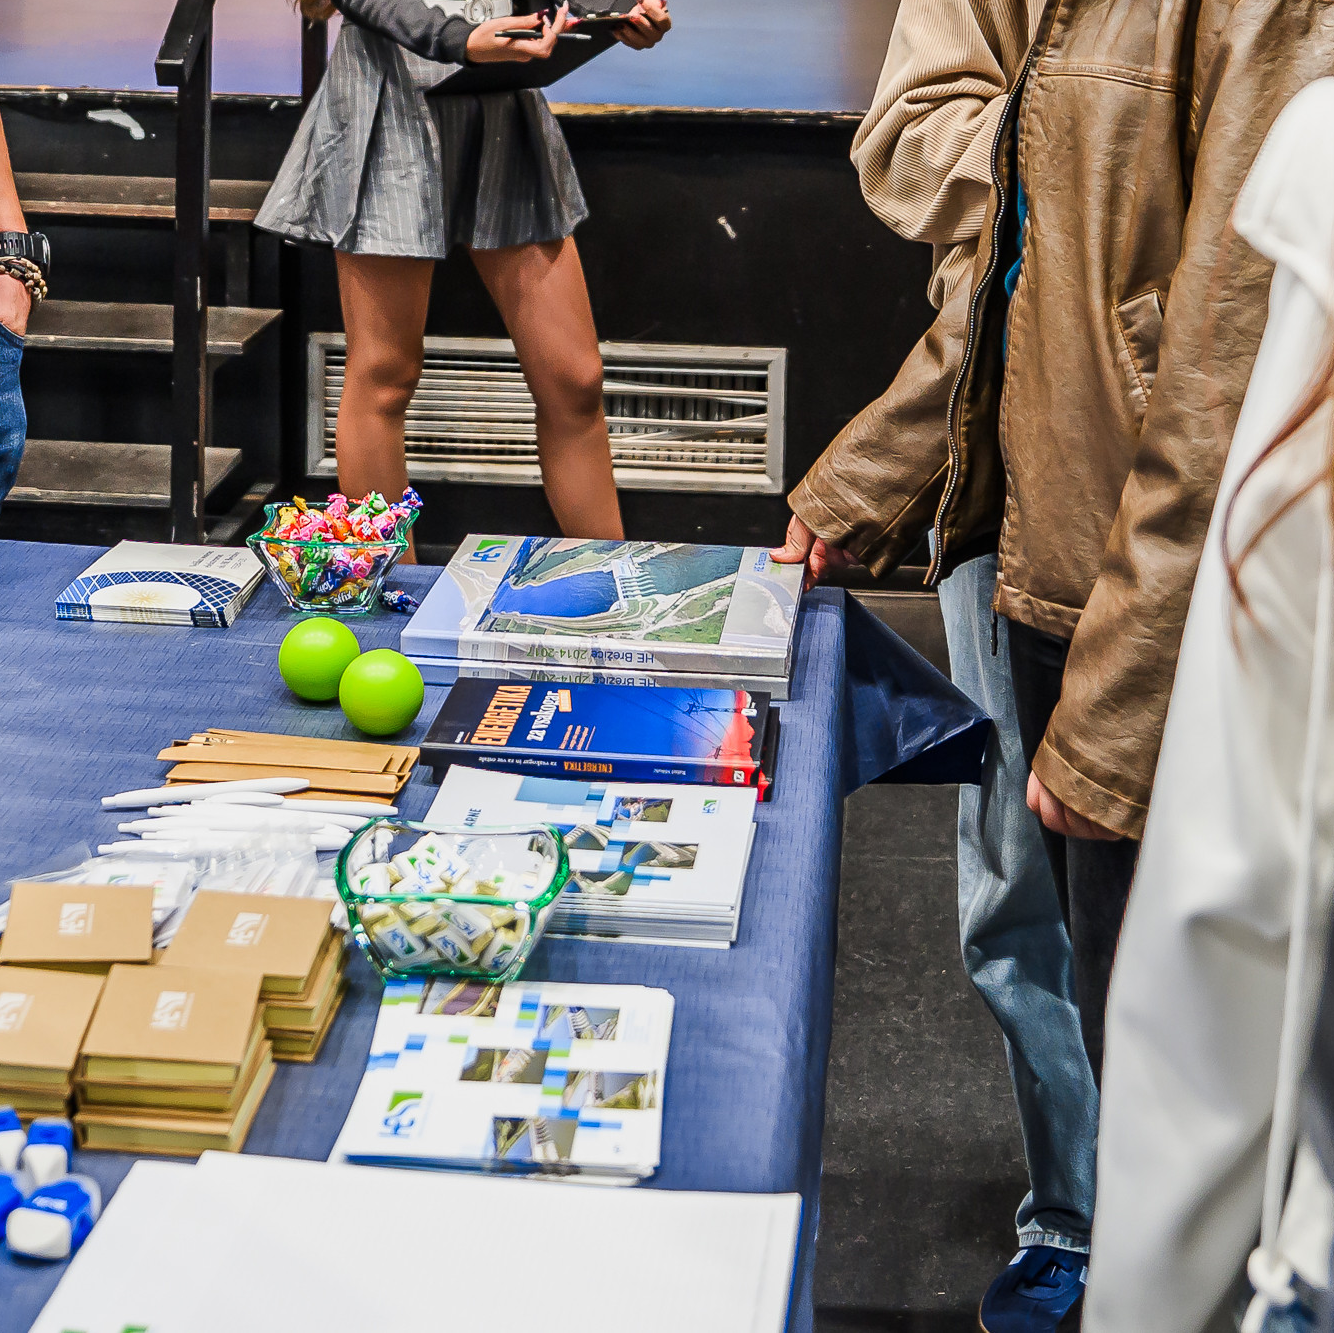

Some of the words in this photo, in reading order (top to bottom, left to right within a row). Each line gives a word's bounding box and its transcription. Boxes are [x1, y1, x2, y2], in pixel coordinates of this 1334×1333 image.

[526, 646, 588, 659] 2014-2017
[590, 648, 633, 662] Brežice
[636, 652, 654, 663] HE
[470, 685, 533, 746] ENERGETIKA
[529, 690, 561, 730] vsakogar
[526, 728, 547, 742] za
[563, 760, 613, 774] ENERGETIKA
